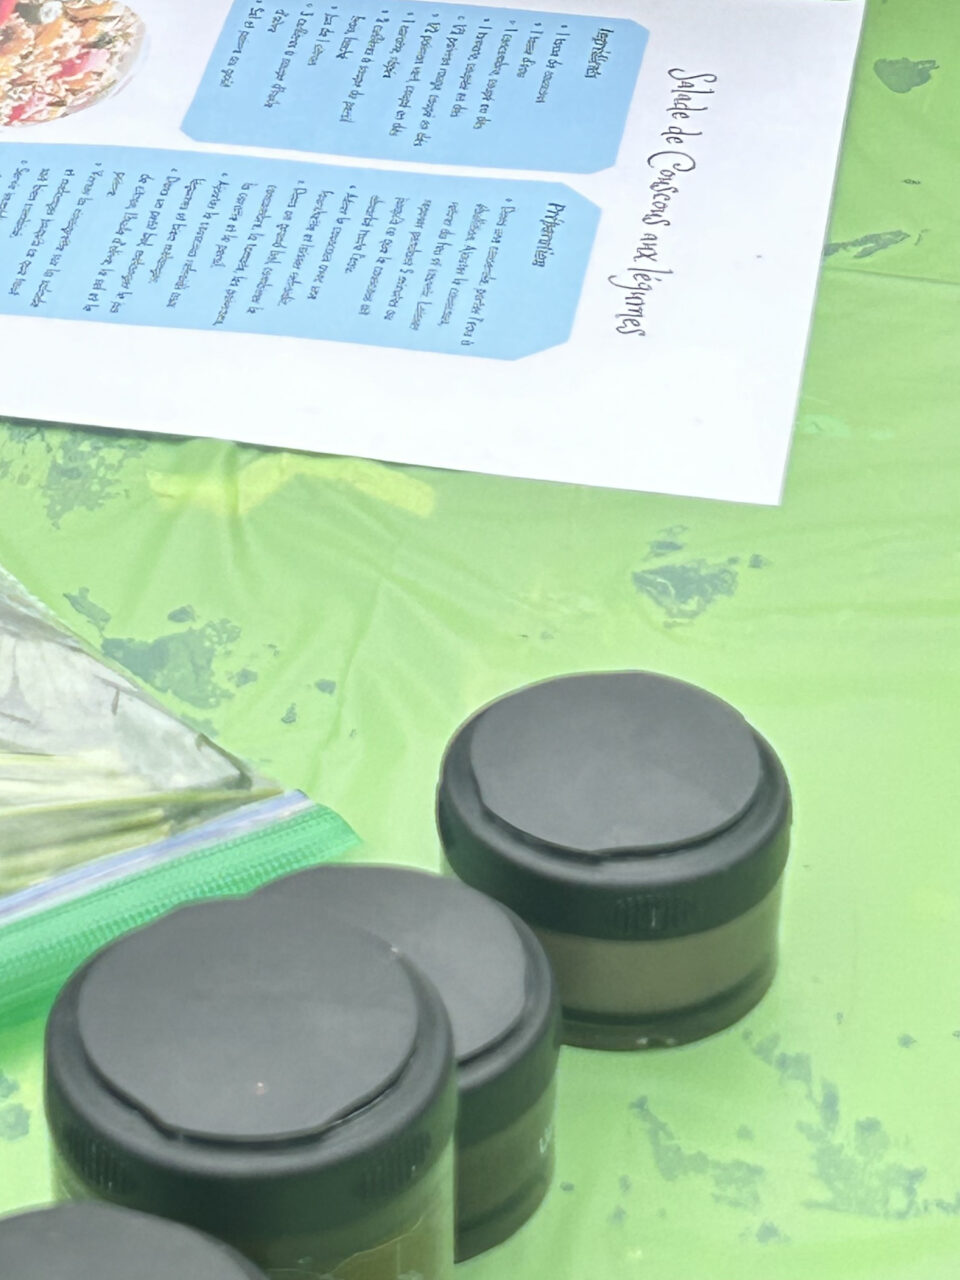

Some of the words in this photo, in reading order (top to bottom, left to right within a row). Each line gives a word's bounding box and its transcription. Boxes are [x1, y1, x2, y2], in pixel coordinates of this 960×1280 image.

[665, 67, 718, 120] Salade
[660, 125, 704, 145] de
[641, 150, 697, 227] Couscous
[632, 232, 659, 263] aux
[607, 267, 675, 337] légumes
